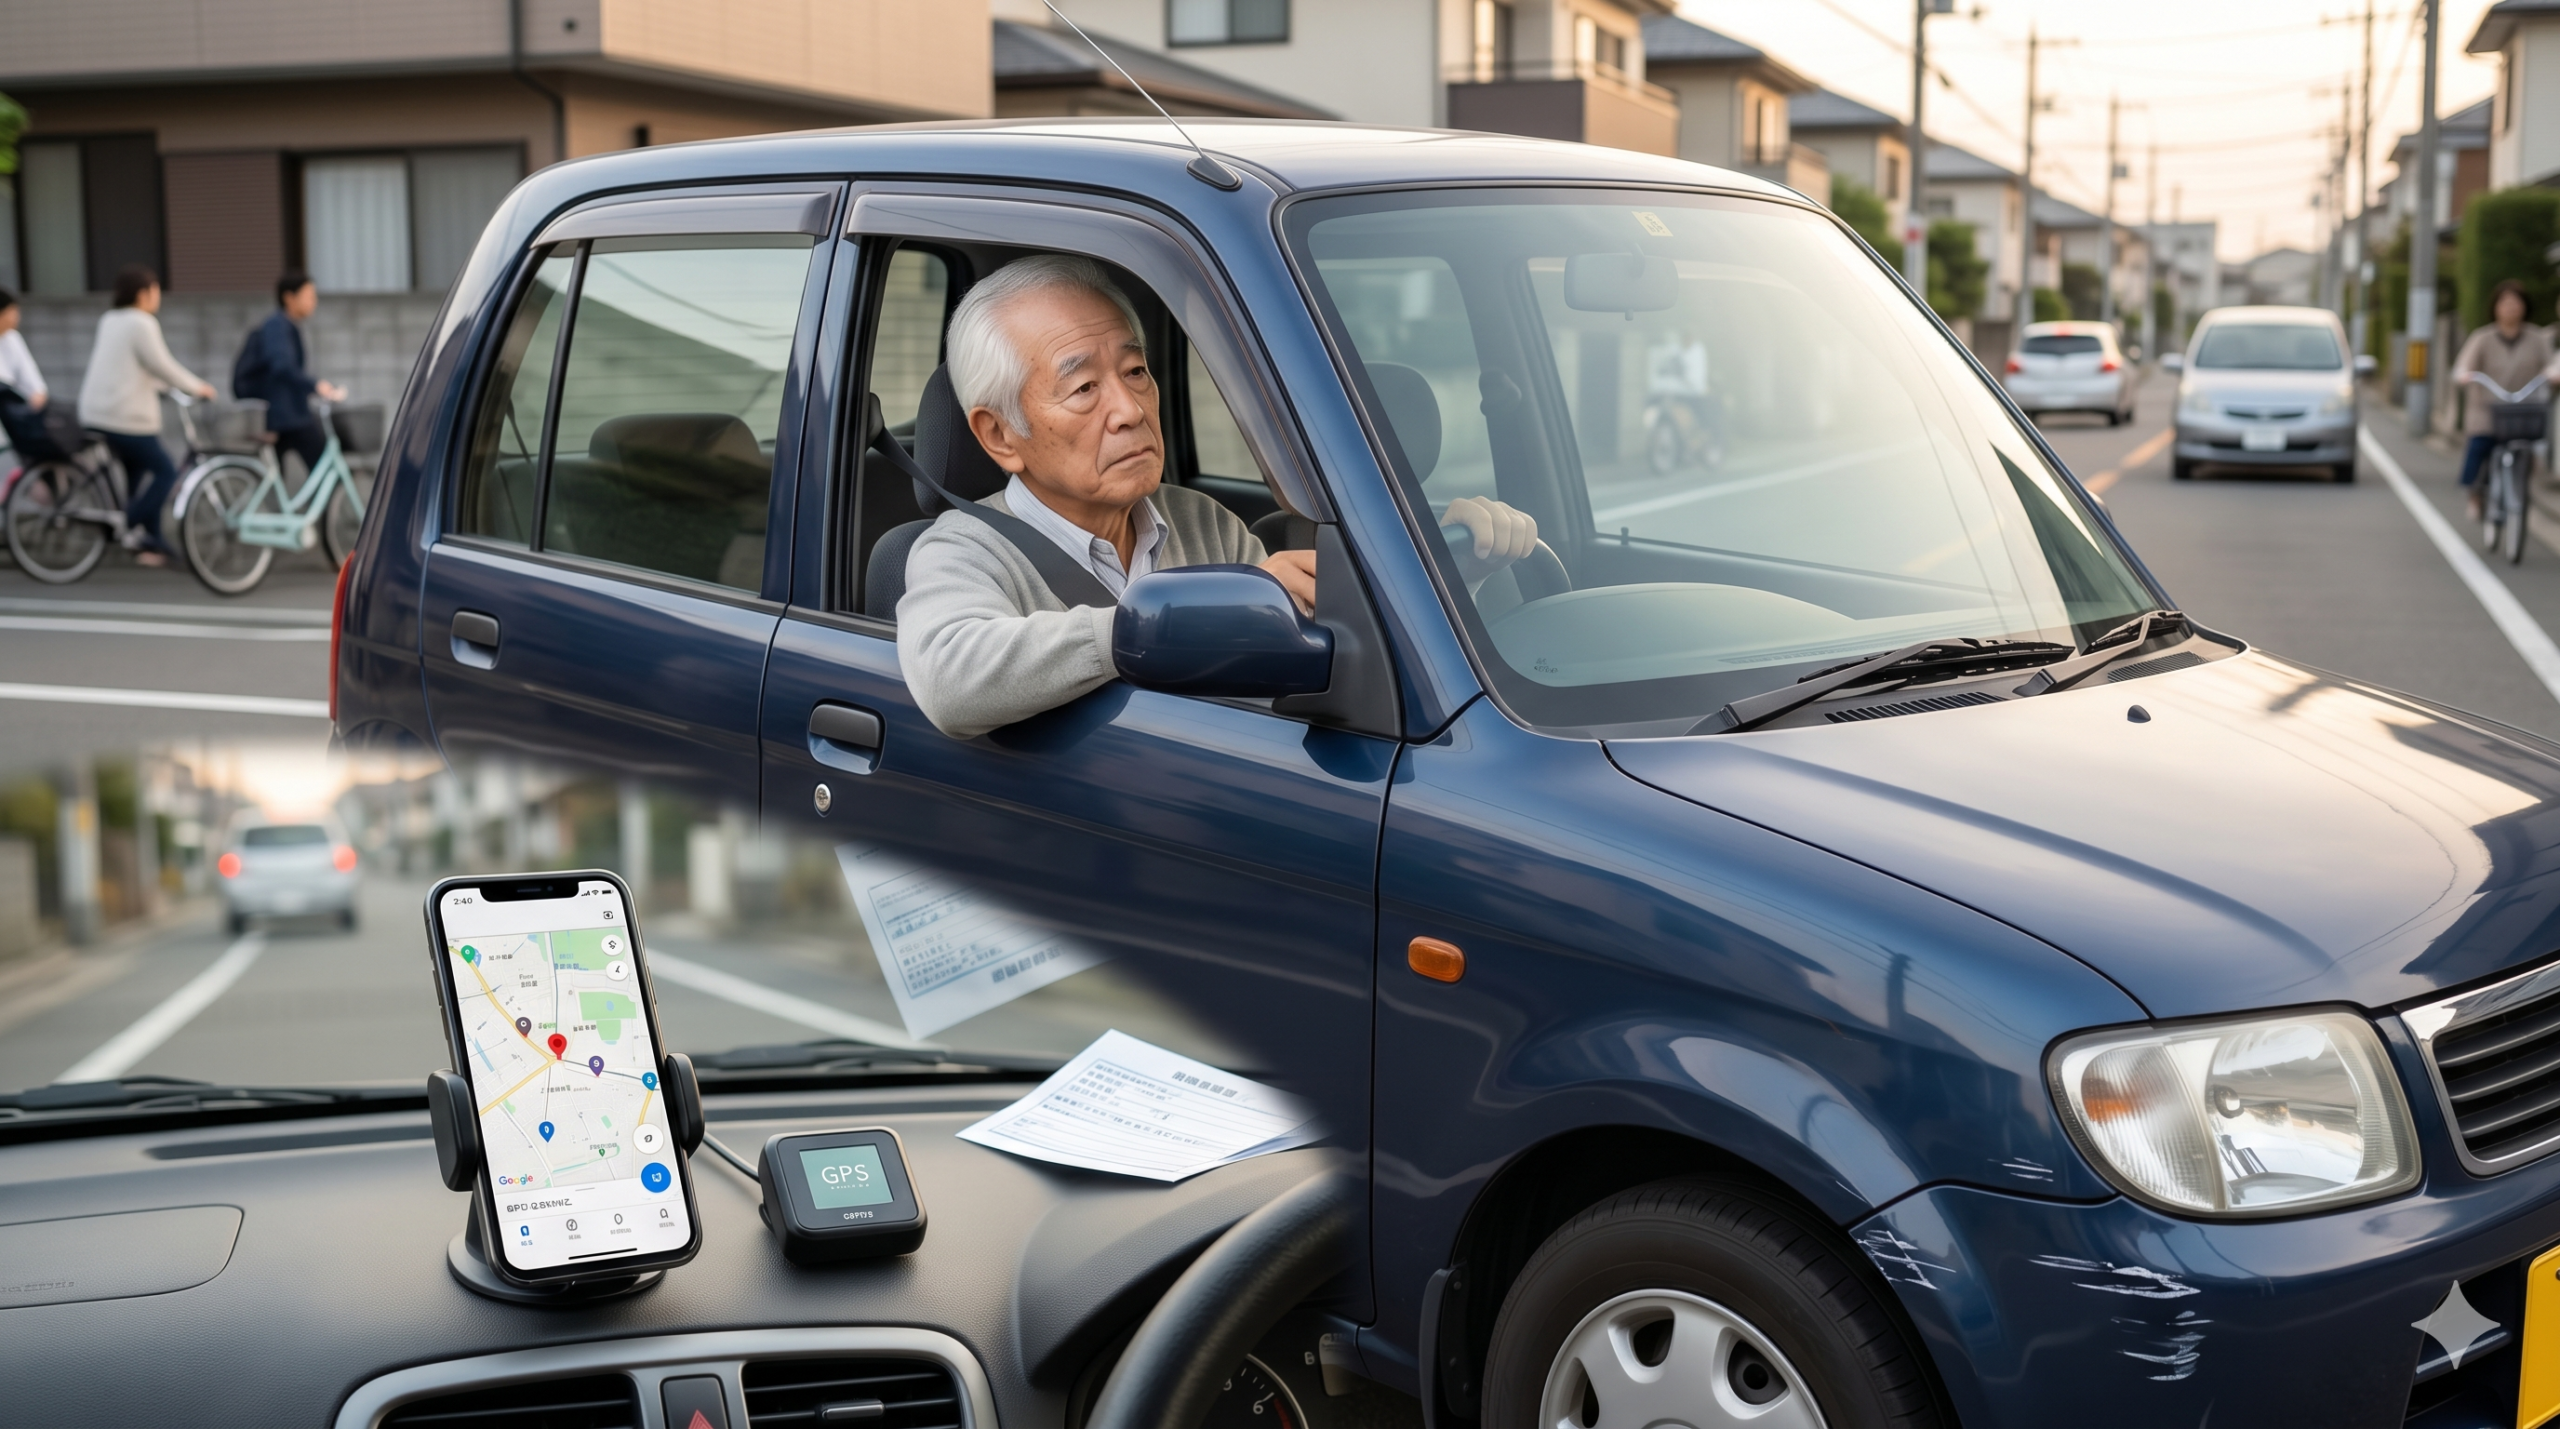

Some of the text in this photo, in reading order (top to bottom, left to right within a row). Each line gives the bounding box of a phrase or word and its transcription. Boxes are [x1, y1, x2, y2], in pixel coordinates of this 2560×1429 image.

[453, 897, 473, 905] 2:40
[498, 1173, 534, 1186] Google
[821, 1164, 869, 1184] GPS
[1252, 1399, 1264, 1415] 6
